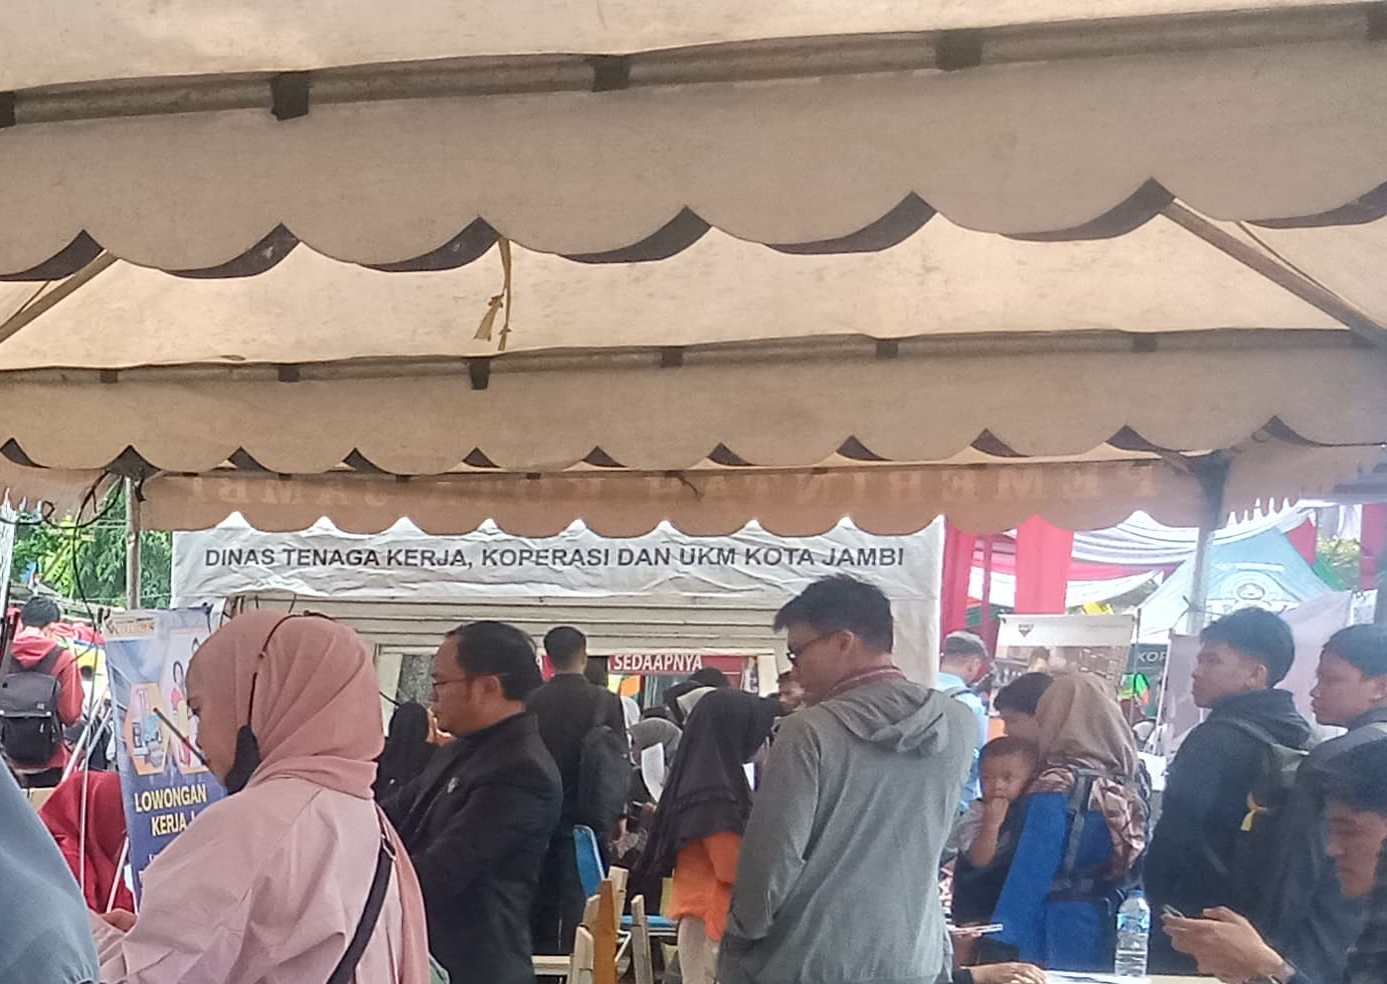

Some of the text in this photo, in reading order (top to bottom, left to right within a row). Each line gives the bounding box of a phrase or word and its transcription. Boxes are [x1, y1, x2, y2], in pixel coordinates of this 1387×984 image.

[205, 547, 904, 569] DINAS TENAGA KERJA, KOPERASI DAN UKM KOTA JAMBI
[614, 654, 703, 672] SEDAAPNYA
[134, 783, 207, 813] LOWONGAN
[151, 812, 188, 837] KERJA
